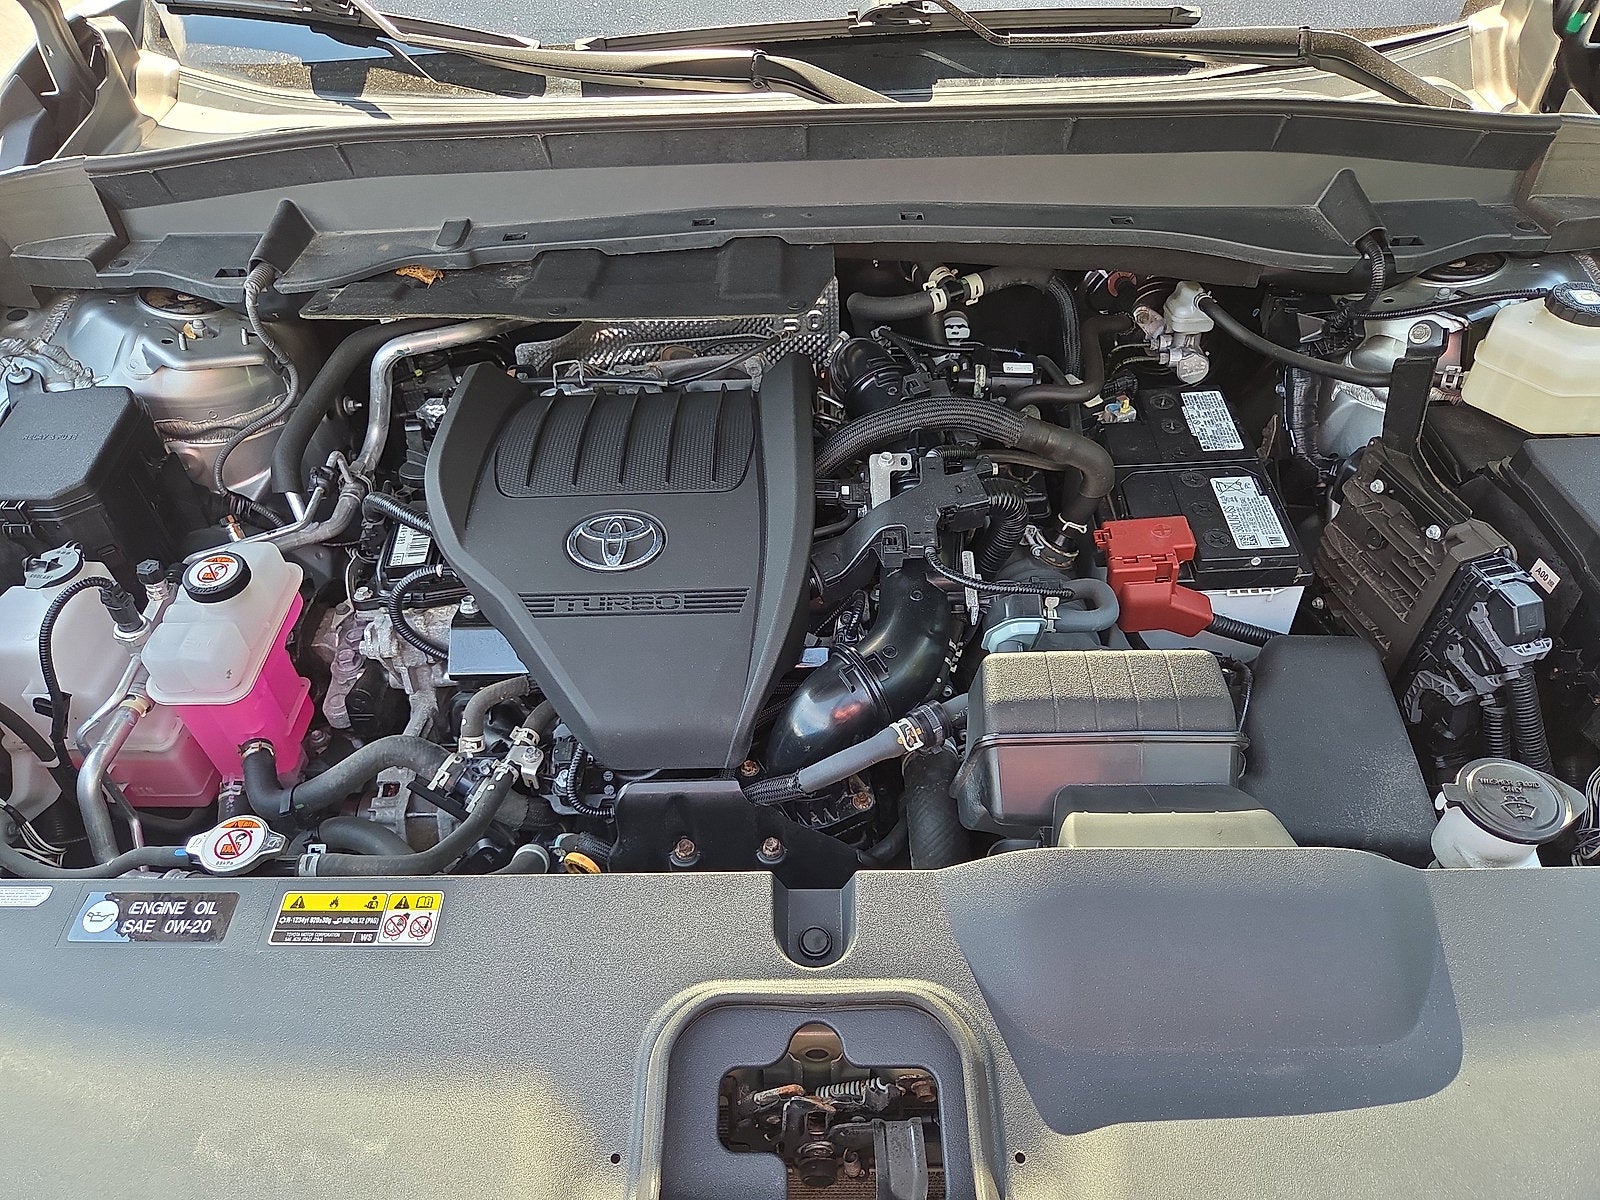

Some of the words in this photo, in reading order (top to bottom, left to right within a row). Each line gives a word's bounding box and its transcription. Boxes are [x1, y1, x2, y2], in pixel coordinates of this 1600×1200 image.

[1535, 566, 1549, 582] A00
[558, 593, 681, 612] TURBO
[1500, 785, 1523, 793] ONLY
[128, 901, 187, 915] ENGINE
[193, 901, 218, 915] OIL
[122, 919, 156, 934] SAE
[164, 919, 212, 934] 0W-20
[360, 933, 373, 941] WS
